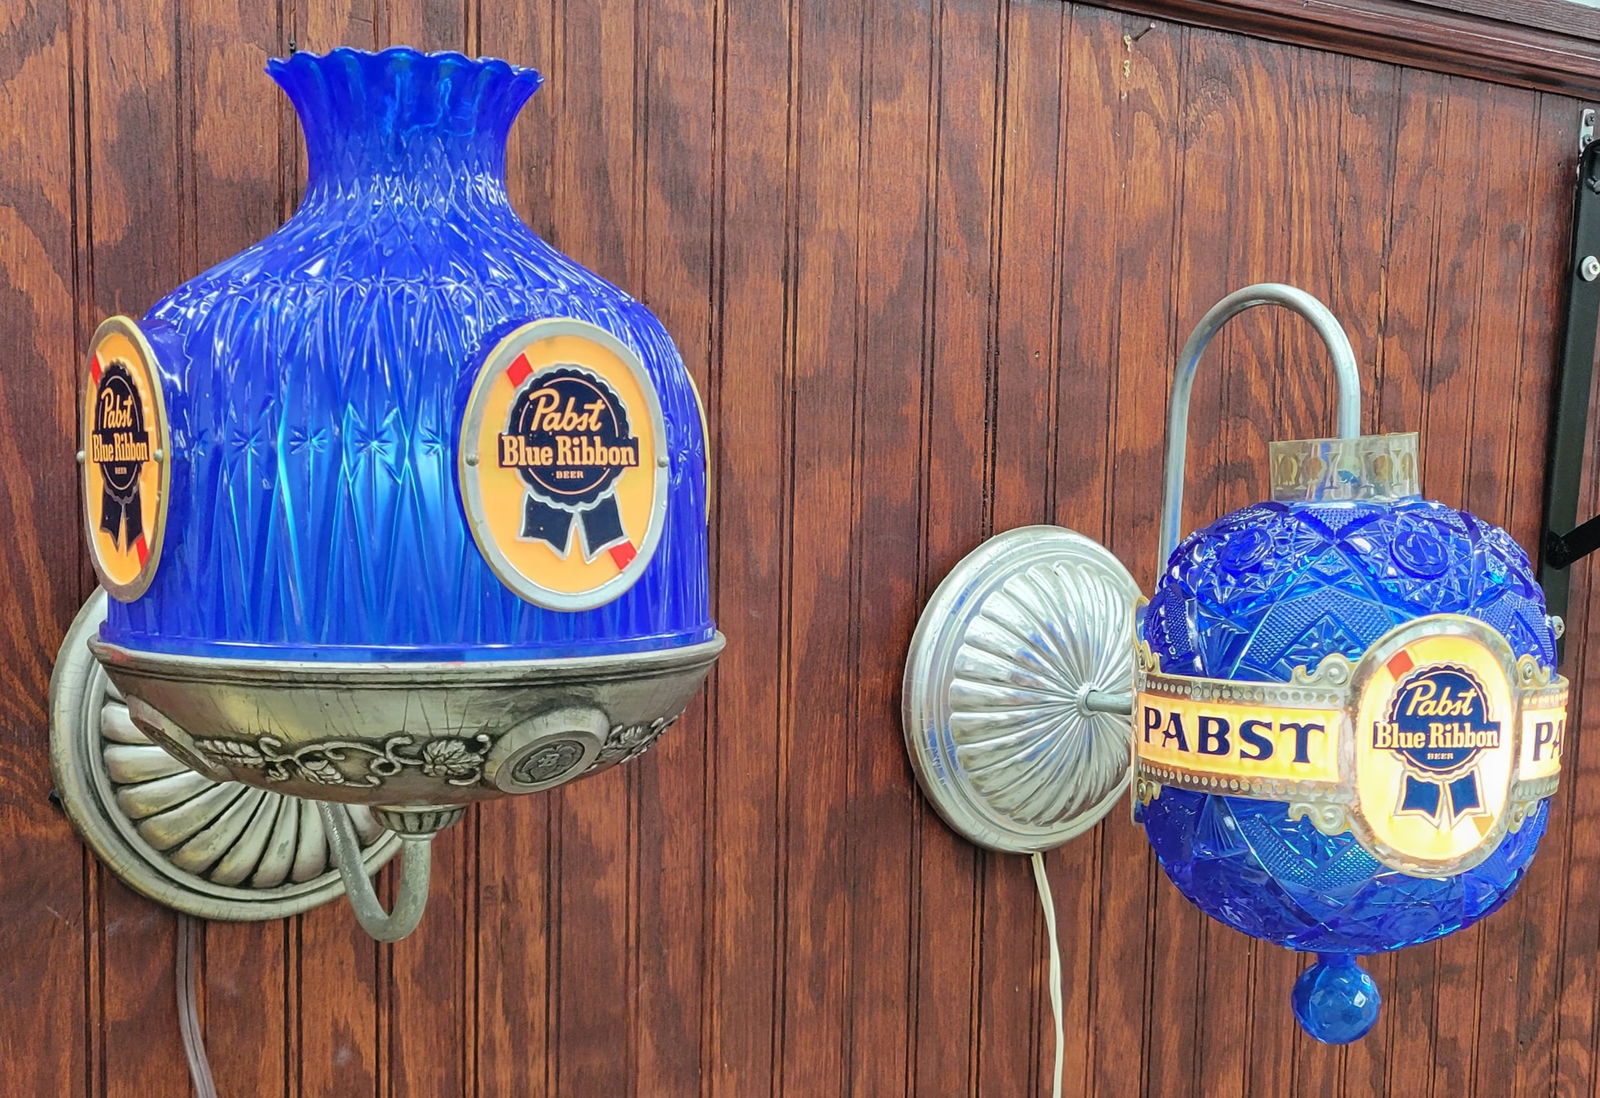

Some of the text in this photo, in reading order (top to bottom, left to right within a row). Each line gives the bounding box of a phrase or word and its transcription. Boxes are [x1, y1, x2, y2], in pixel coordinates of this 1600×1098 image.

[101, 387, 133, 429] Pabst
[528, 388, 606, 432] Pabst
[93, 432, 148, 462] Blue Ribbon
[502, 436, 637, 466] Blue Ribbon
[555, 470, 584, 480] BEER
[1406, 679, 1477, 716] Pabst
[1143, 706, 1325, 764] PABST
[1375, 722, 1498, 748] Blue Ribbon
[1427, 752, 1454, 760] BEER
